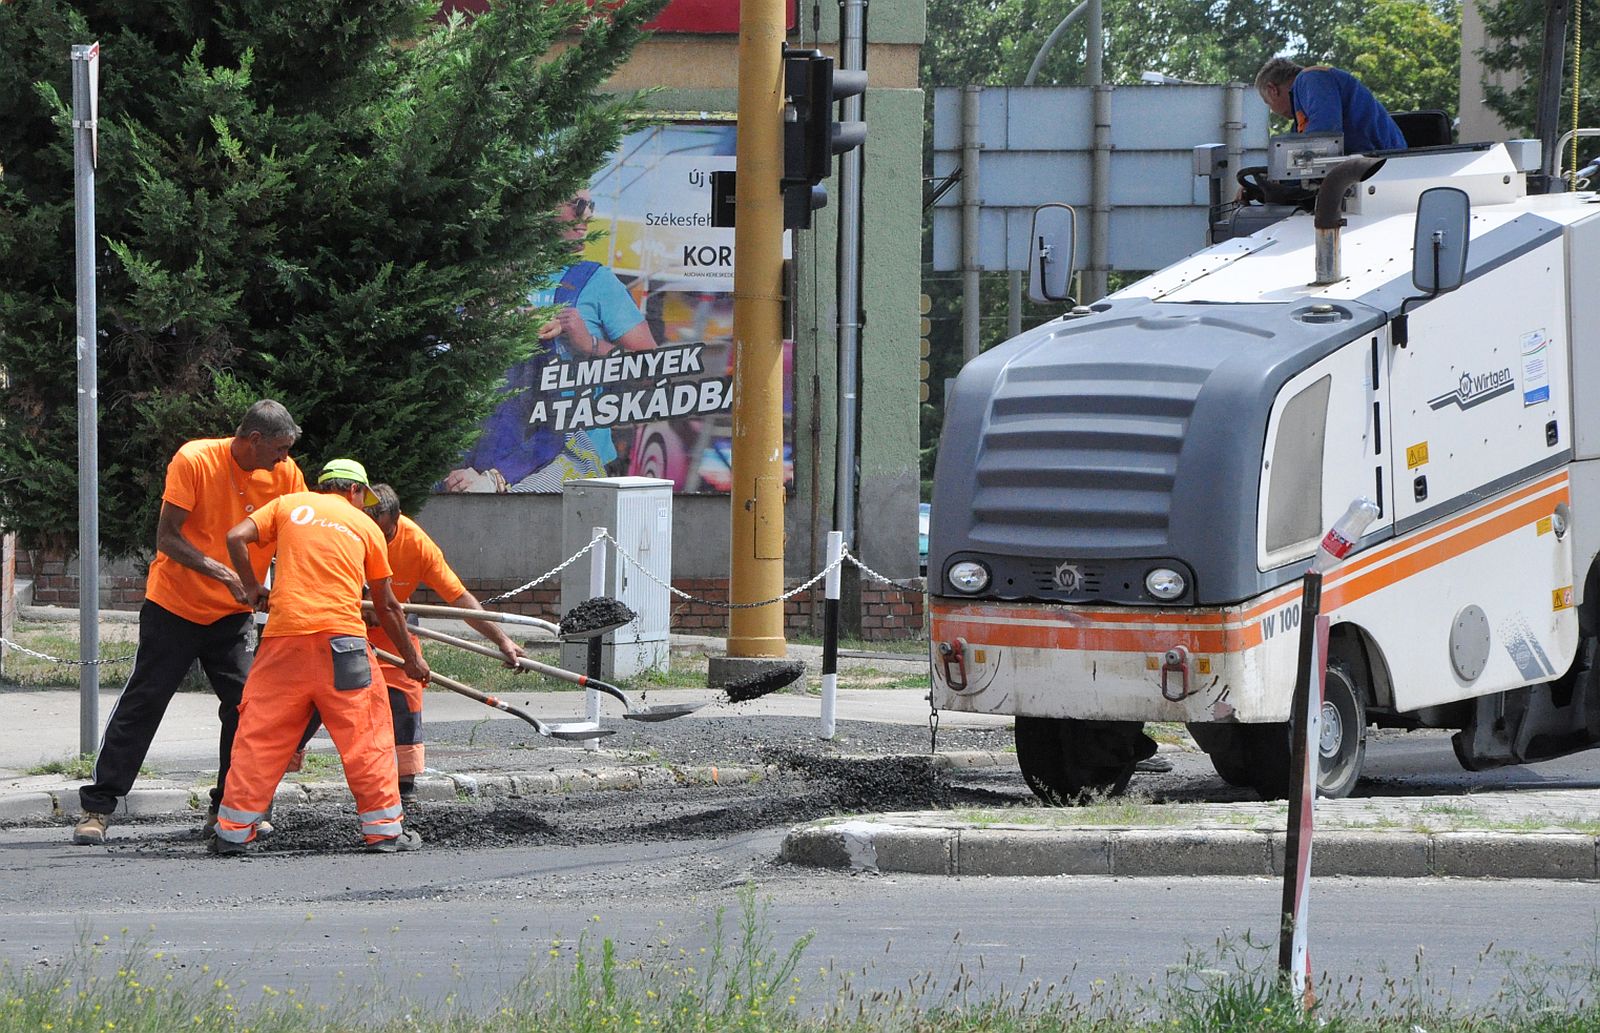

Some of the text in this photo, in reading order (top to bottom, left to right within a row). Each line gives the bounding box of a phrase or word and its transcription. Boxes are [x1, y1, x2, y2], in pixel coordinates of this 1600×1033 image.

[689, 168, 704, 188] Új
[540, 346, 703, 391] ÉLMÉNYEK
[1473, 367, 1511, 392] Wirtgen
[529, 401, 547, 424] A
[1262, 603, 1300, 640] W 100
